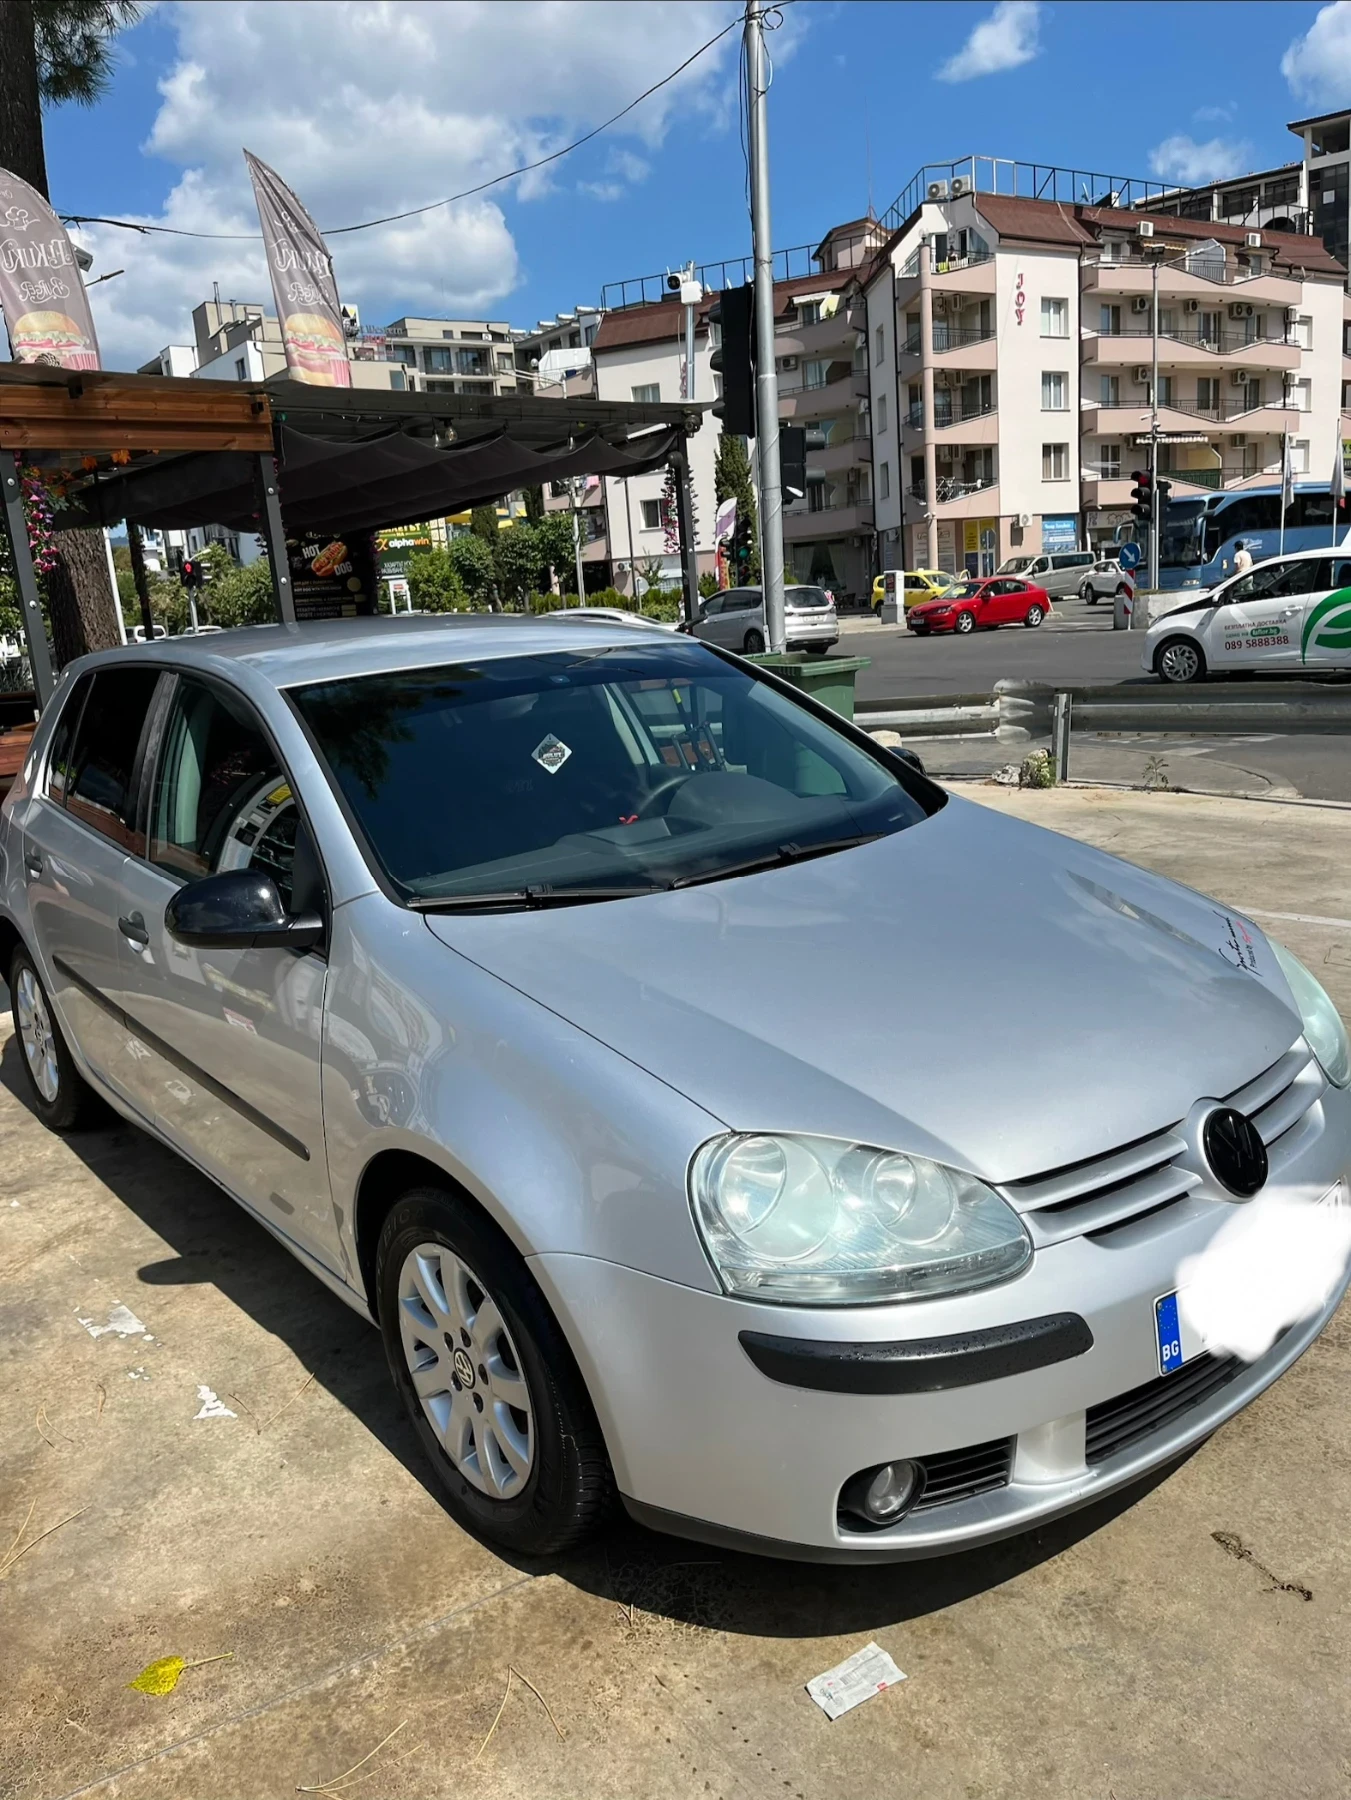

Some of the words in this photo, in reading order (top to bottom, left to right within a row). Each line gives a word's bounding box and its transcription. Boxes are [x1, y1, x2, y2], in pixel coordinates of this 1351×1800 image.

[1015, 273, 1026, 326] JOY
[388, 537, 429, 549] alphawin
[302, 543, 321, 559] HOT
[333, 561, 353, 576] DOG
[1224, 622, 1256, 631] БЕЗПЛАТНА
[1256, 619, 1287, 628] ДОСТАВКА
[1225, 640, 1243, 650] 089
[1245, 635, 1289, 648] 5888388
[1162, 1340, 1179, 1362] BG
